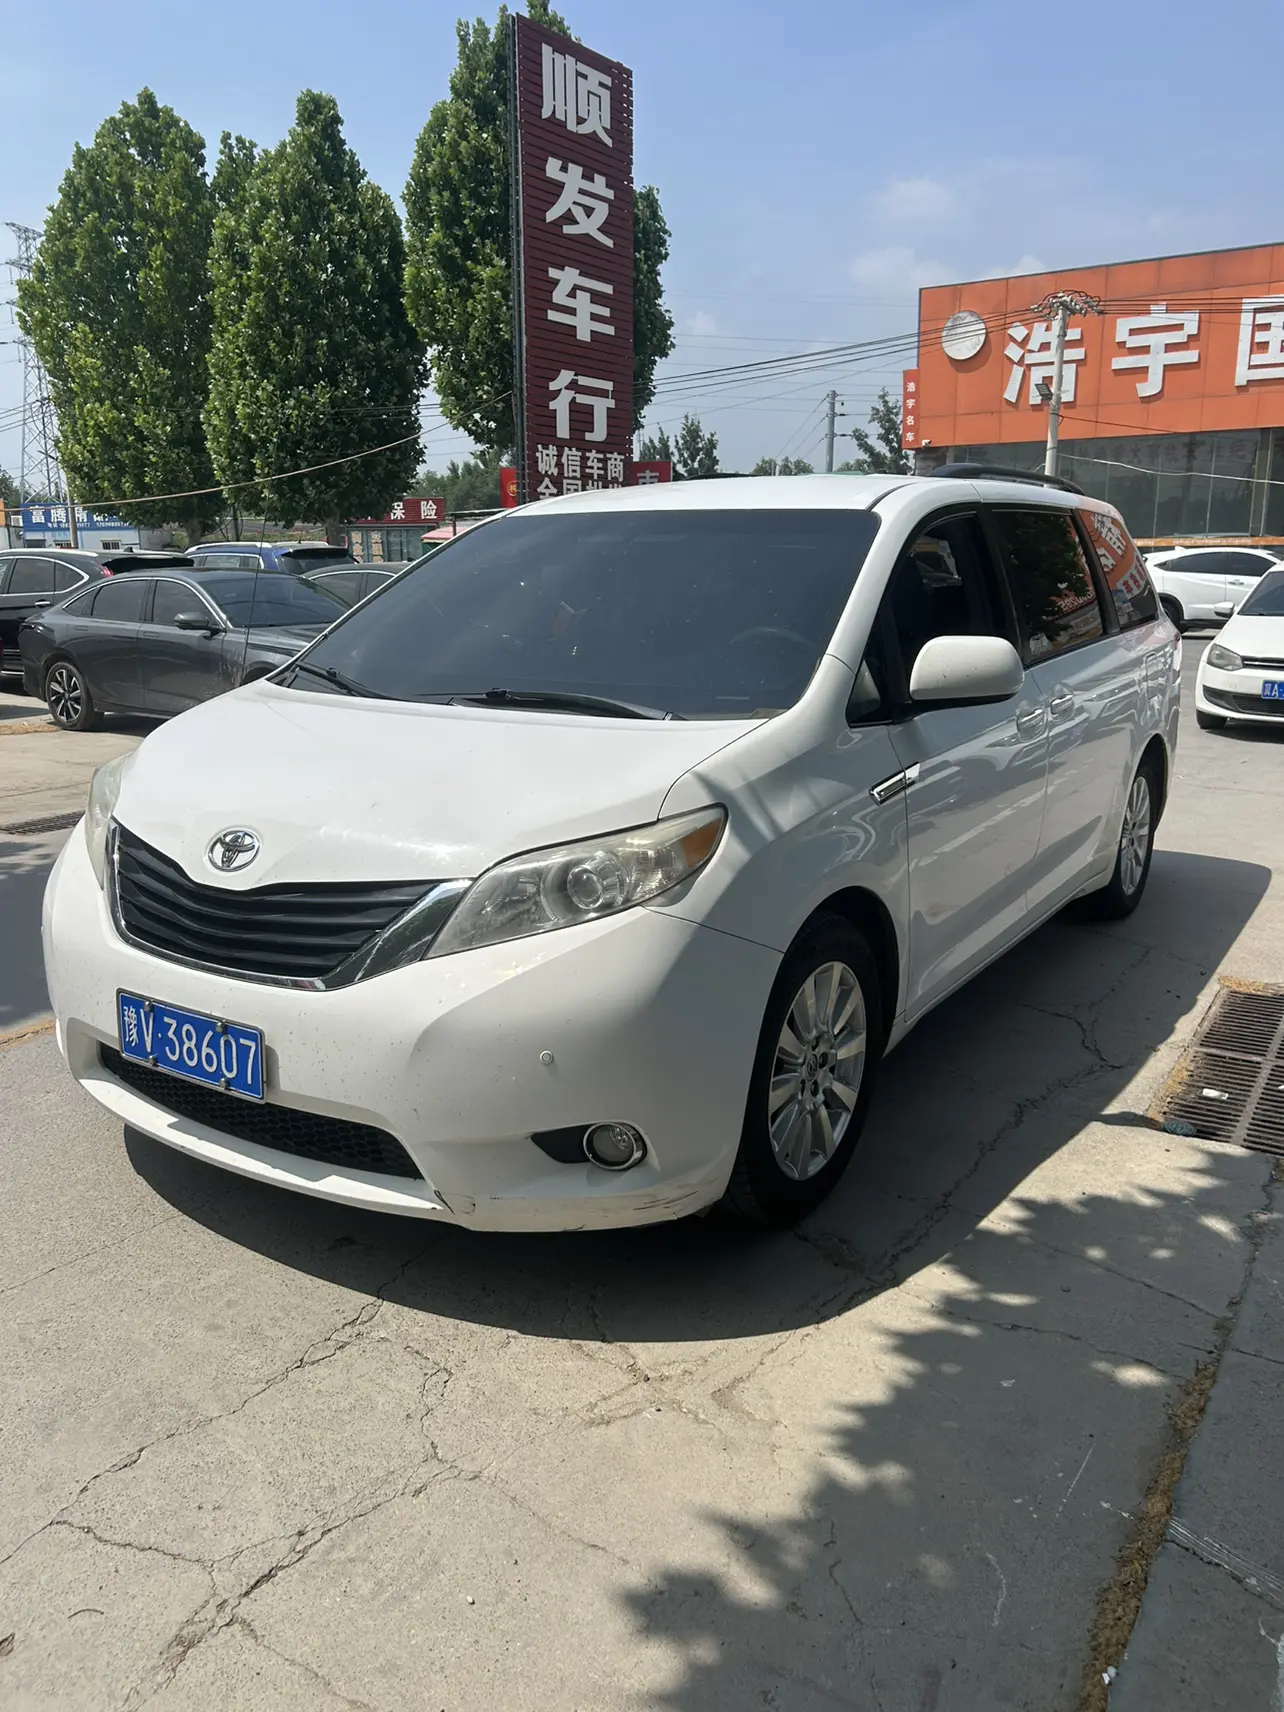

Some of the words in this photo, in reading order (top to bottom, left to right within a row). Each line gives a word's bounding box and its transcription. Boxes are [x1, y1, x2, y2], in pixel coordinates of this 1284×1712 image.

[541, 42, 615, 443] 顺发车行
[905, 381, 916, 442] 浩宇名车
[536, 444, 625, 482] 诚信车商
[536, 476, 623, 500] 全国
